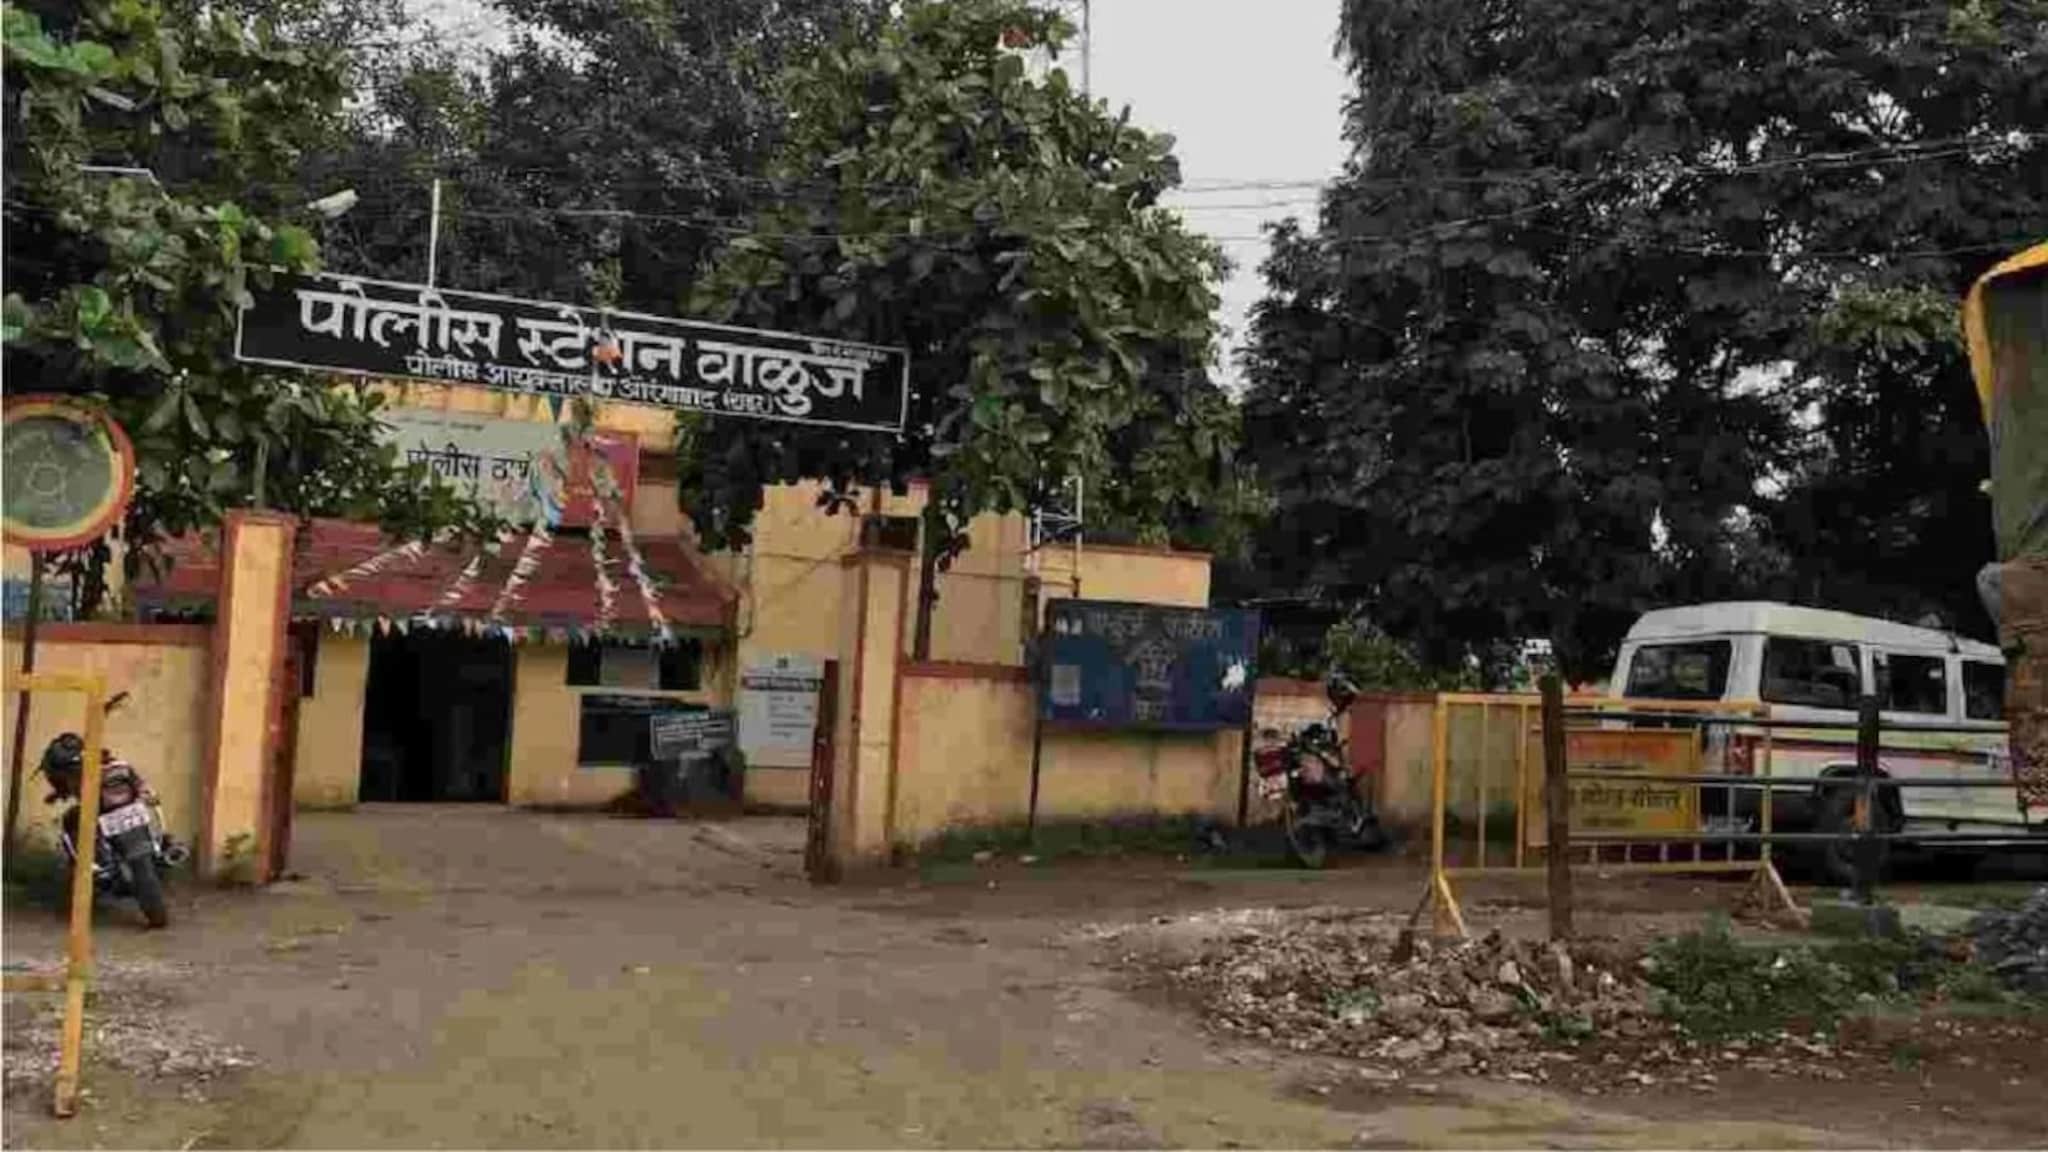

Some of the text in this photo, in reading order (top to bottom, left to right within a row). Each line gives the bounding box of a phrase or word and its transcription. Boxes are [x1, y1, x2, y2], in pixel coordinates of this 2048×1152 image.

[296, 279, 503, 358] पोलीस
[696, 340, 871, 416] वाळुज
[404, 350, 478, 379] पोलीस
